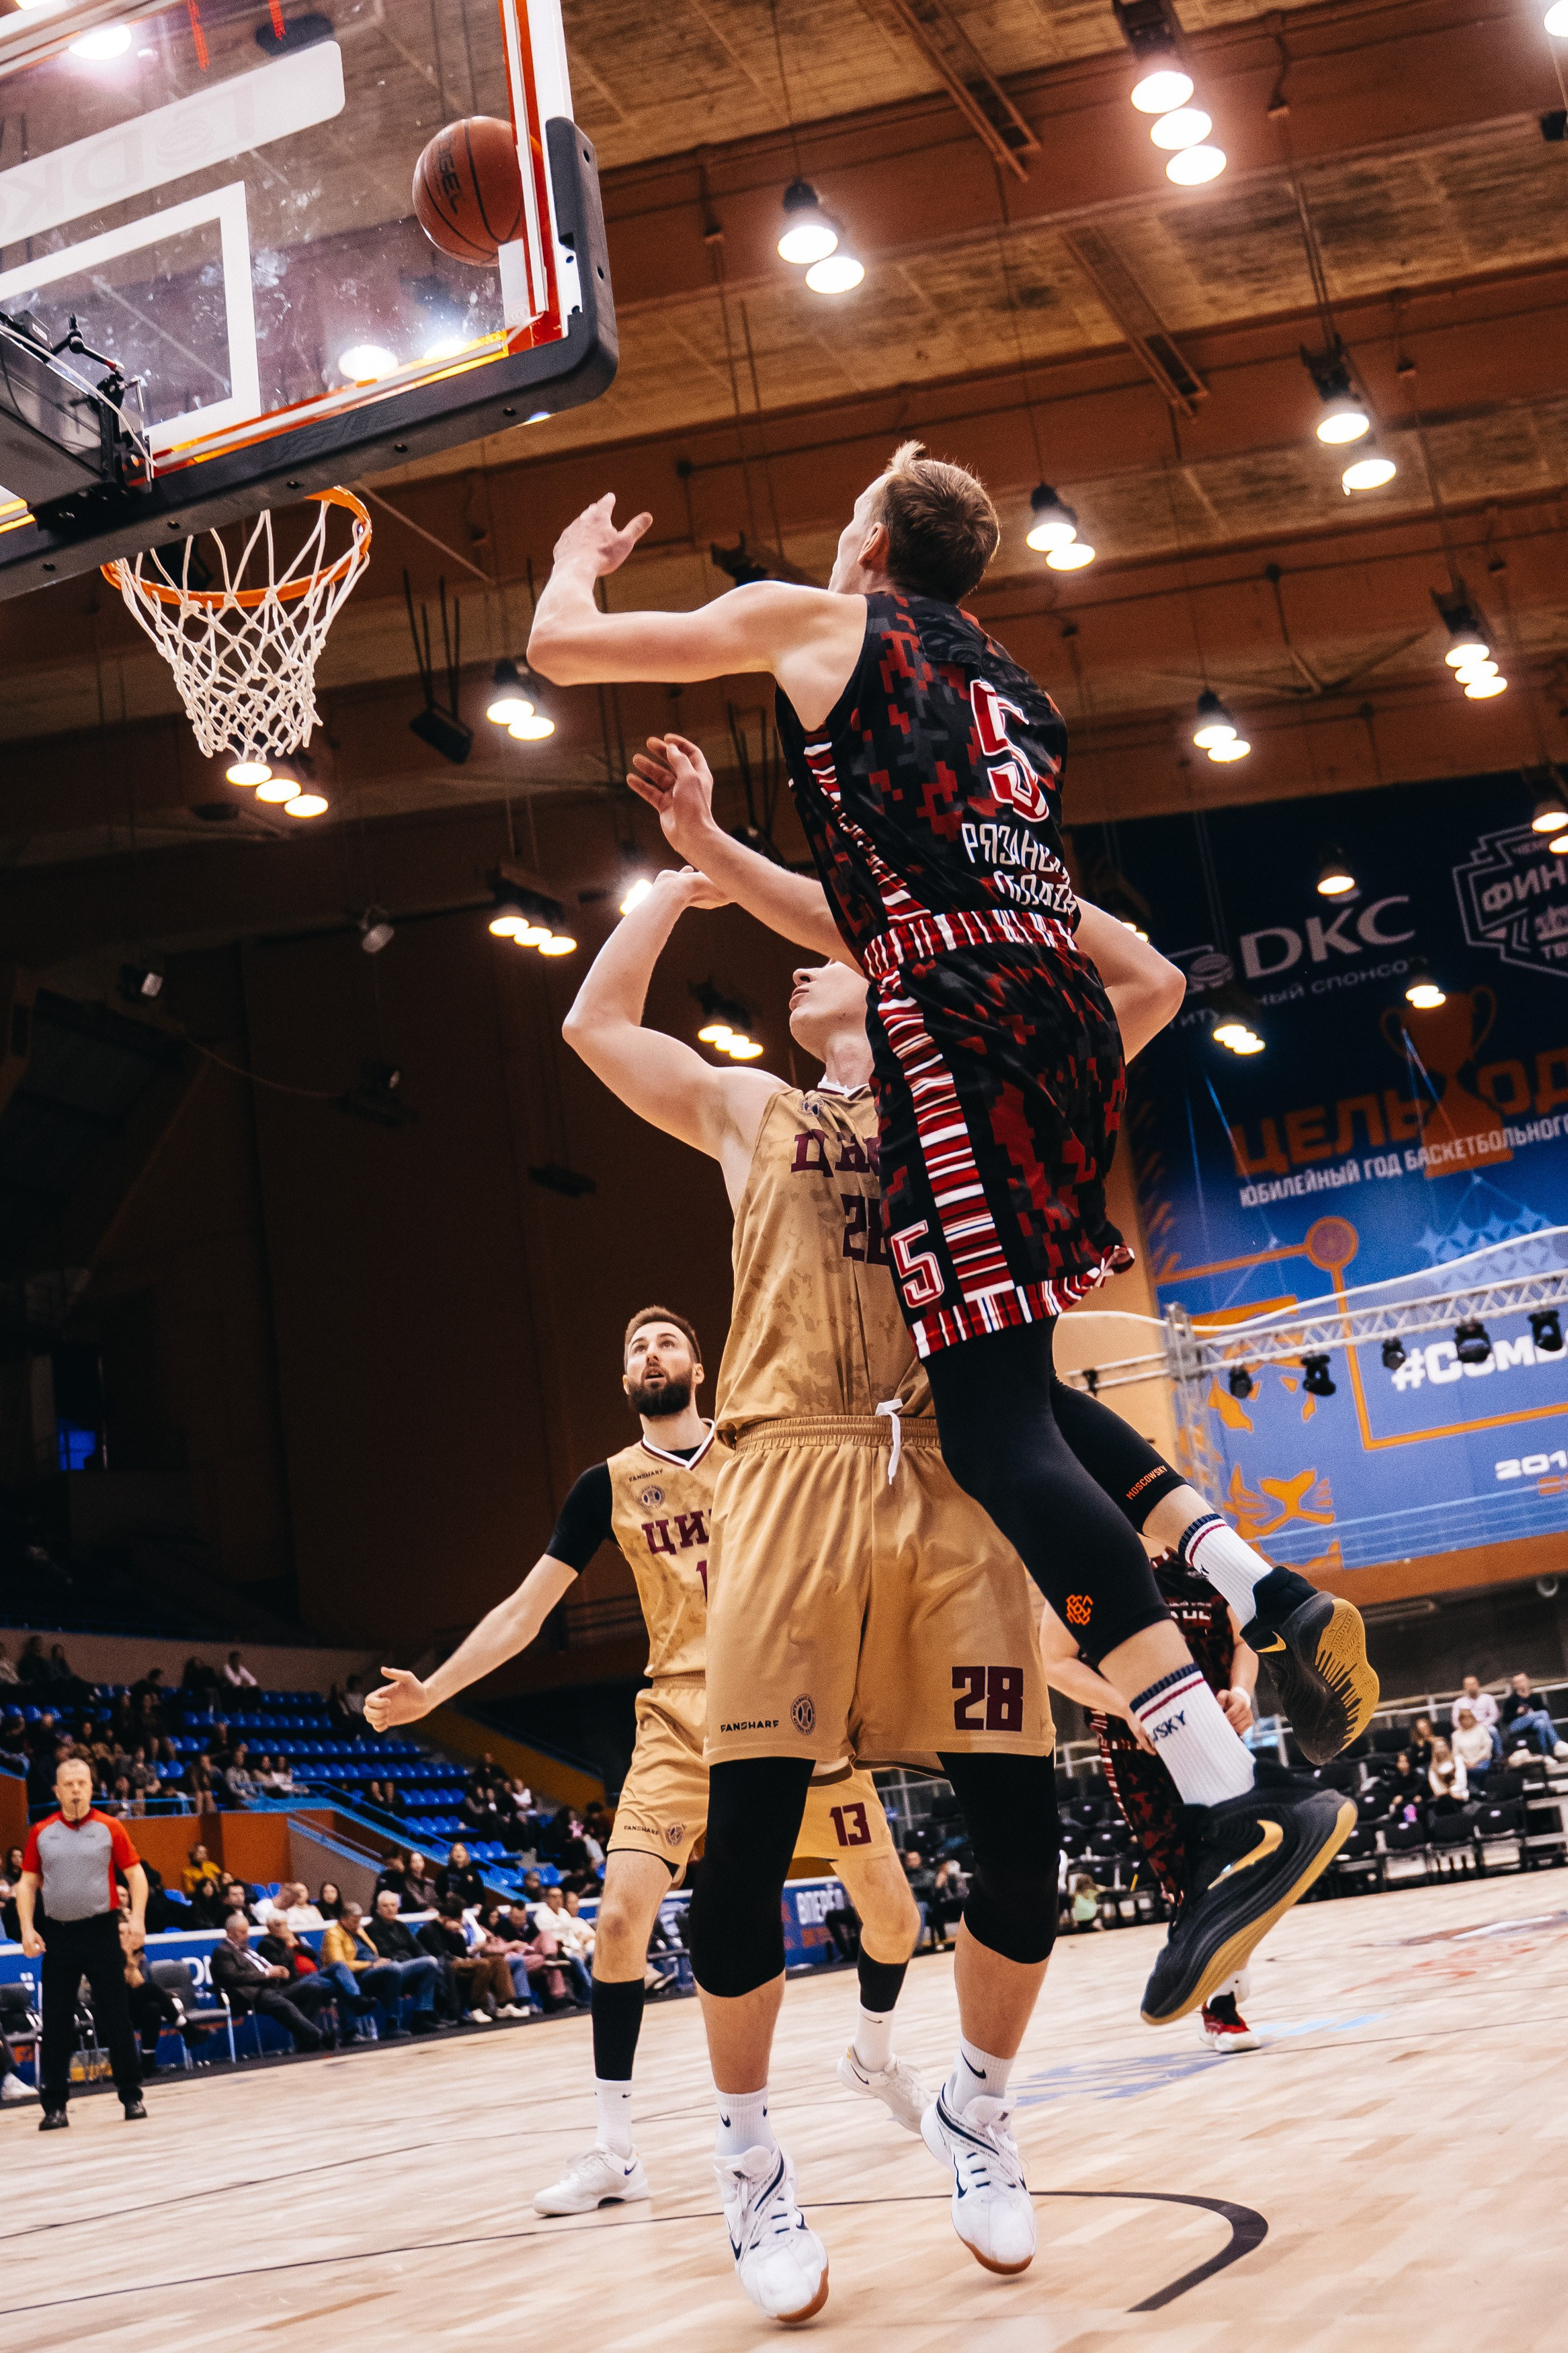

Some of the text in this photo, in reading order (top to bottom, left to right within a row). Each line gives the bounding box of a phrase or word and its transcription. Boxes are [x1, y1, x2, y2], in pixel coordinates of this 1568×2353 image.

[970, 679, 1049, 822] 5
[1239, 895, 1415, 979] DKC
[1311, 955, 1429, 994] спонсо
[1234, 1089, 1430, 1177] ЦЕЛЬ
[1239, 1158, 1360, 1208] ЮБИЛЕЙНЫЙ
[1364, 1150, 1403, 1181] ГОД
[890, 1219, 945, 1308] 5
[1126, 1465, 1168, 1500] MOSCOWSKY
[1494, 1449, 1568, 1481] 201
[641, 1508, 712, 1555] ЦИ
[951, 1665, 1024, 1732] 28
[829, 1802, 872, 1847] 13
